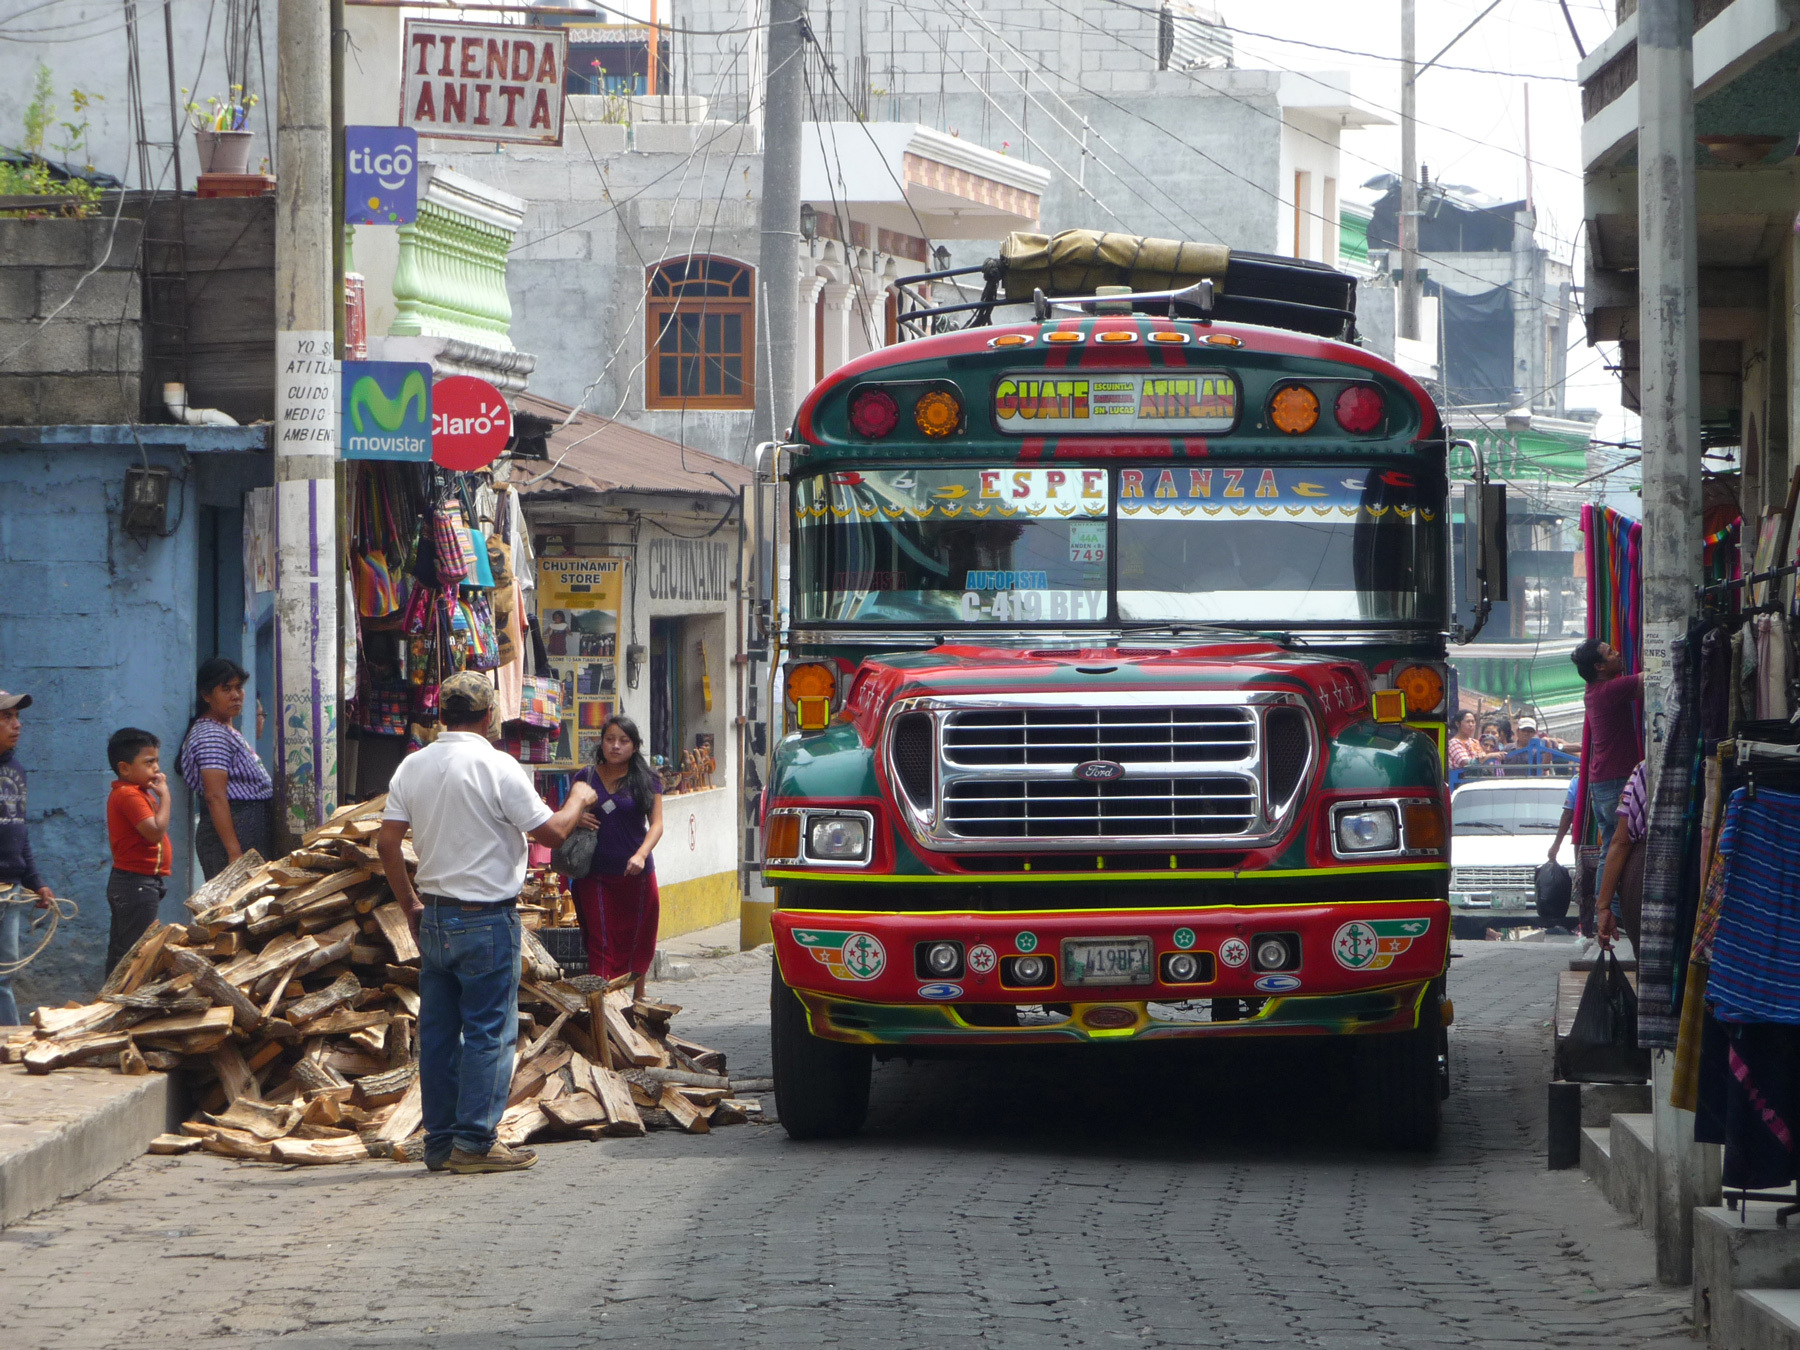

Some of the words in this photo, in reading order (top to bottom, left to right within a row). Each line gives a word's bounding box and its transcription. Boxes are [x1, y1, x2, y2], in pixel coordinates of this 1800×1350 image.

[412, 33, 557, 84] TIENDA
[414, 80, 552, 130] ANITA
[297, 340, 315, 354] YO
[286, 360, 333, 374] ATITLA
[288, 386, 328, 400] CUIDO
[1093, 382, 1134, 391] ESCUINTLA
[996, 379, 1090, 420] GUATE
[1138, 379, 1235, 419] ATITLAN
[284, 408, 326, 421] MEDIO
[1109, 406, 1135, 415] LUCAS
[431, 413, 492, 435] Claro
[283, 428, 334, 441] AMBIENT
[349, 436, 426, 453] movistar
[542, 561, 619, 572] CHUTINAMIT
[650, 538, 728, 601] CHUTINAMIT
[560, 574, 601, 585] STORE
[966, 571, 1048, 590] AUTOPISTA
[961, 591, 1042, 622] C-419
[1050, 591, 1108, 621] BFY
[1085, 764, 1113, 777] Ford
